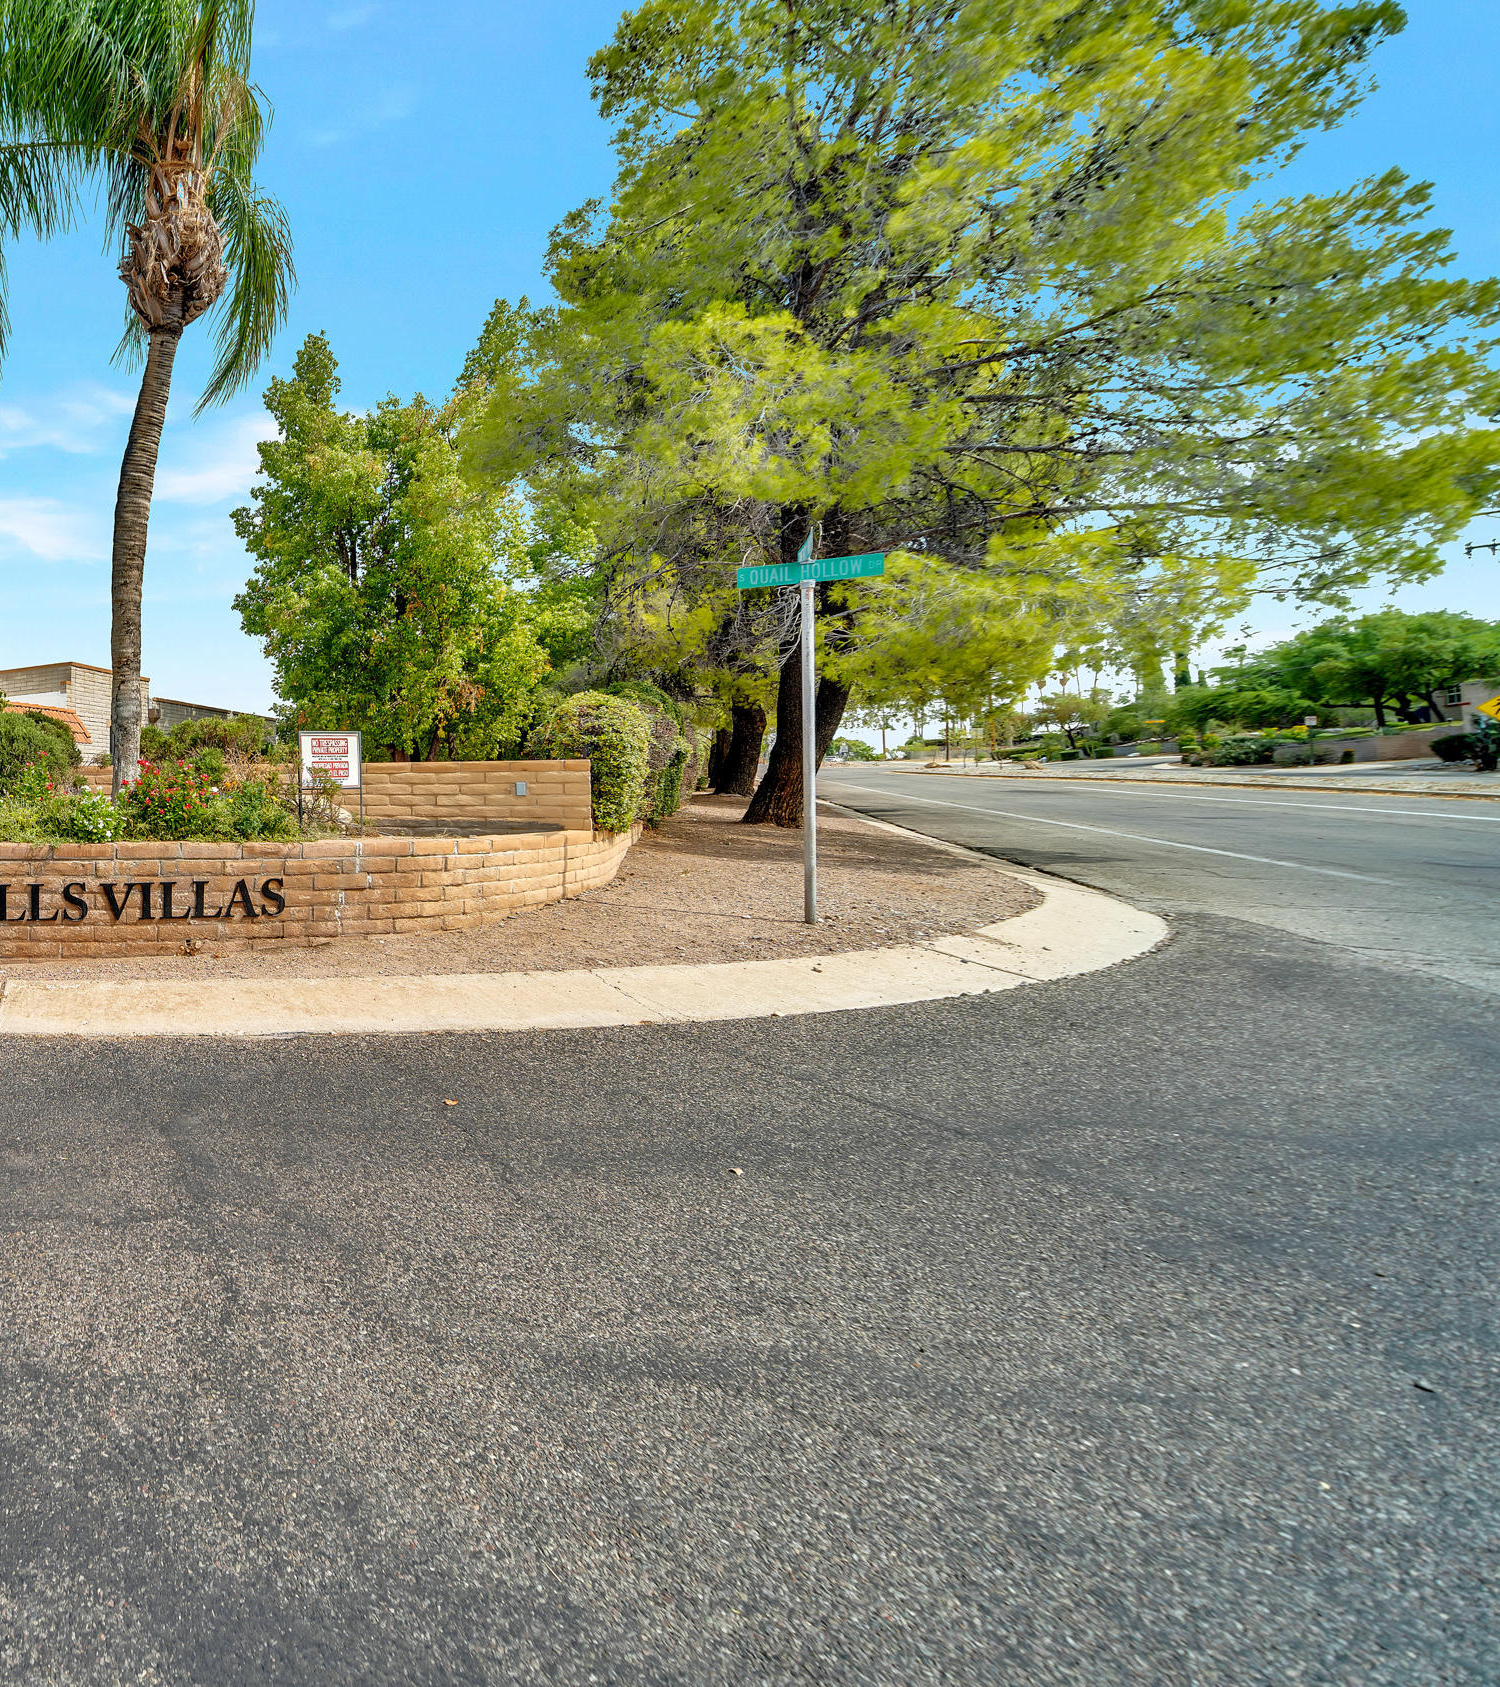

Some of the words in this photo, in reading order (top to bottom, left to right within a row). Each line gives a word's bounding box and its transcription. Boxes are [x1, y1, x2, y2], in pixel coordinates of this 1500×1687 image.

[740, 574, 745, 582] S
[750, 567, 792, 585] QUAIL
[801, 559, 862, 579] HOLLOW
[869, 560, 883, 569] DR
[99, 877, 286, 920] VILLAS
